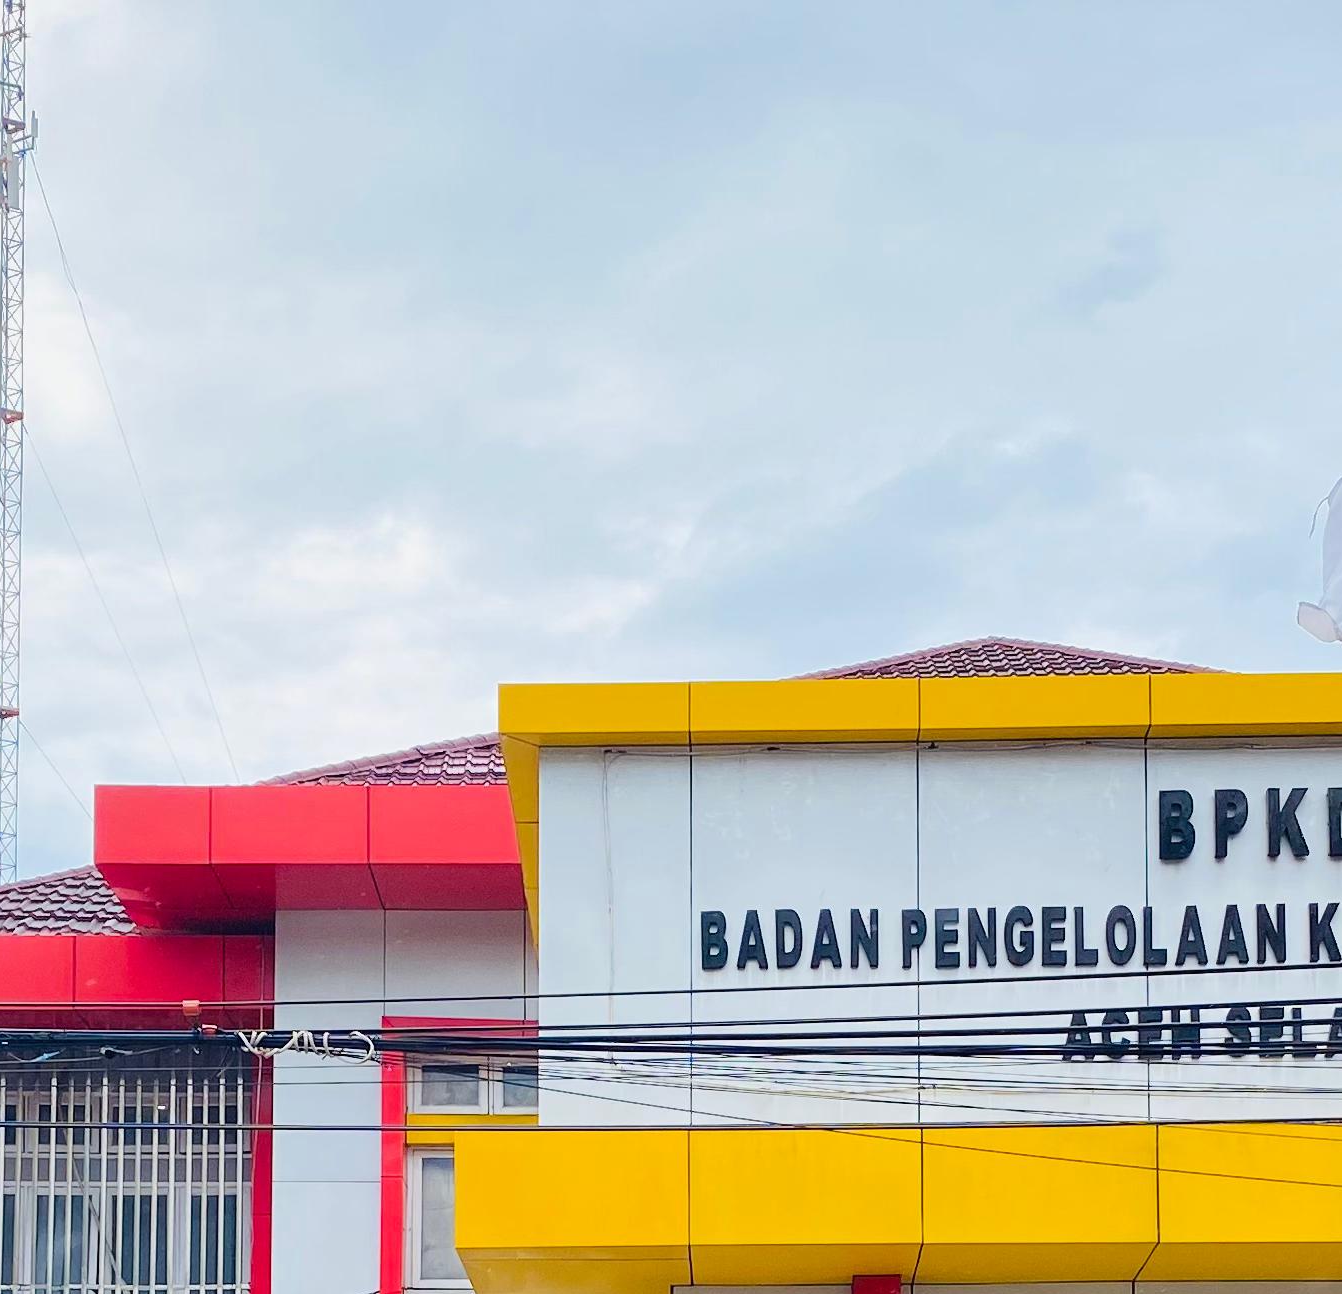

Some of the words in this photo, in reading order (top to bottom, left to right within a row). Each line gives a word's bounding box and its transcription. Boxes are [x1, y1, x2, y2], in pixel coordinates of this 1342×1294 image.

[700, 908, 879, 971] BADAN
[901, 903, 1287, 970] PENGELOLAAN
[1061, 1004, 1201, 1062] ACEH
